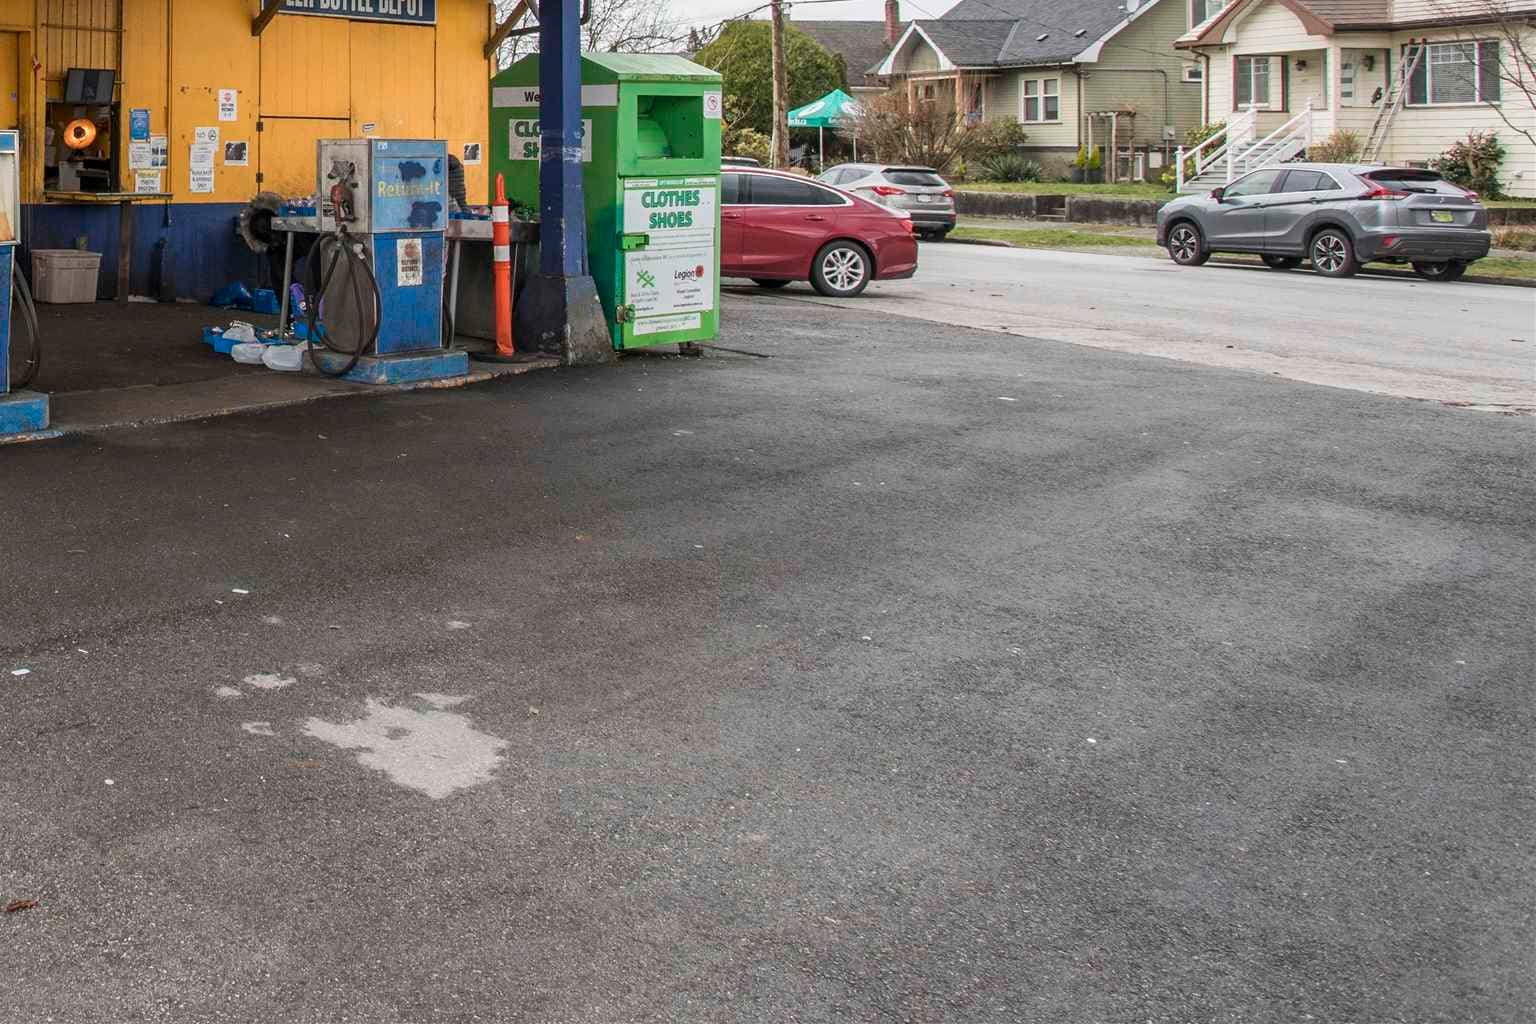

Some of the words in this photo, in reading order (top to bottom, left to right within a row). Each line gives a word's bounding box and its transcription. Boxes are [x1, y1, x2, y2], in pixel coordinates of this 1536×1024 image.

[640, 189, 700, 209] CLOTHES
[648, 210, 694, 229] SHOES
[674, 269, 695, 281] Legion
